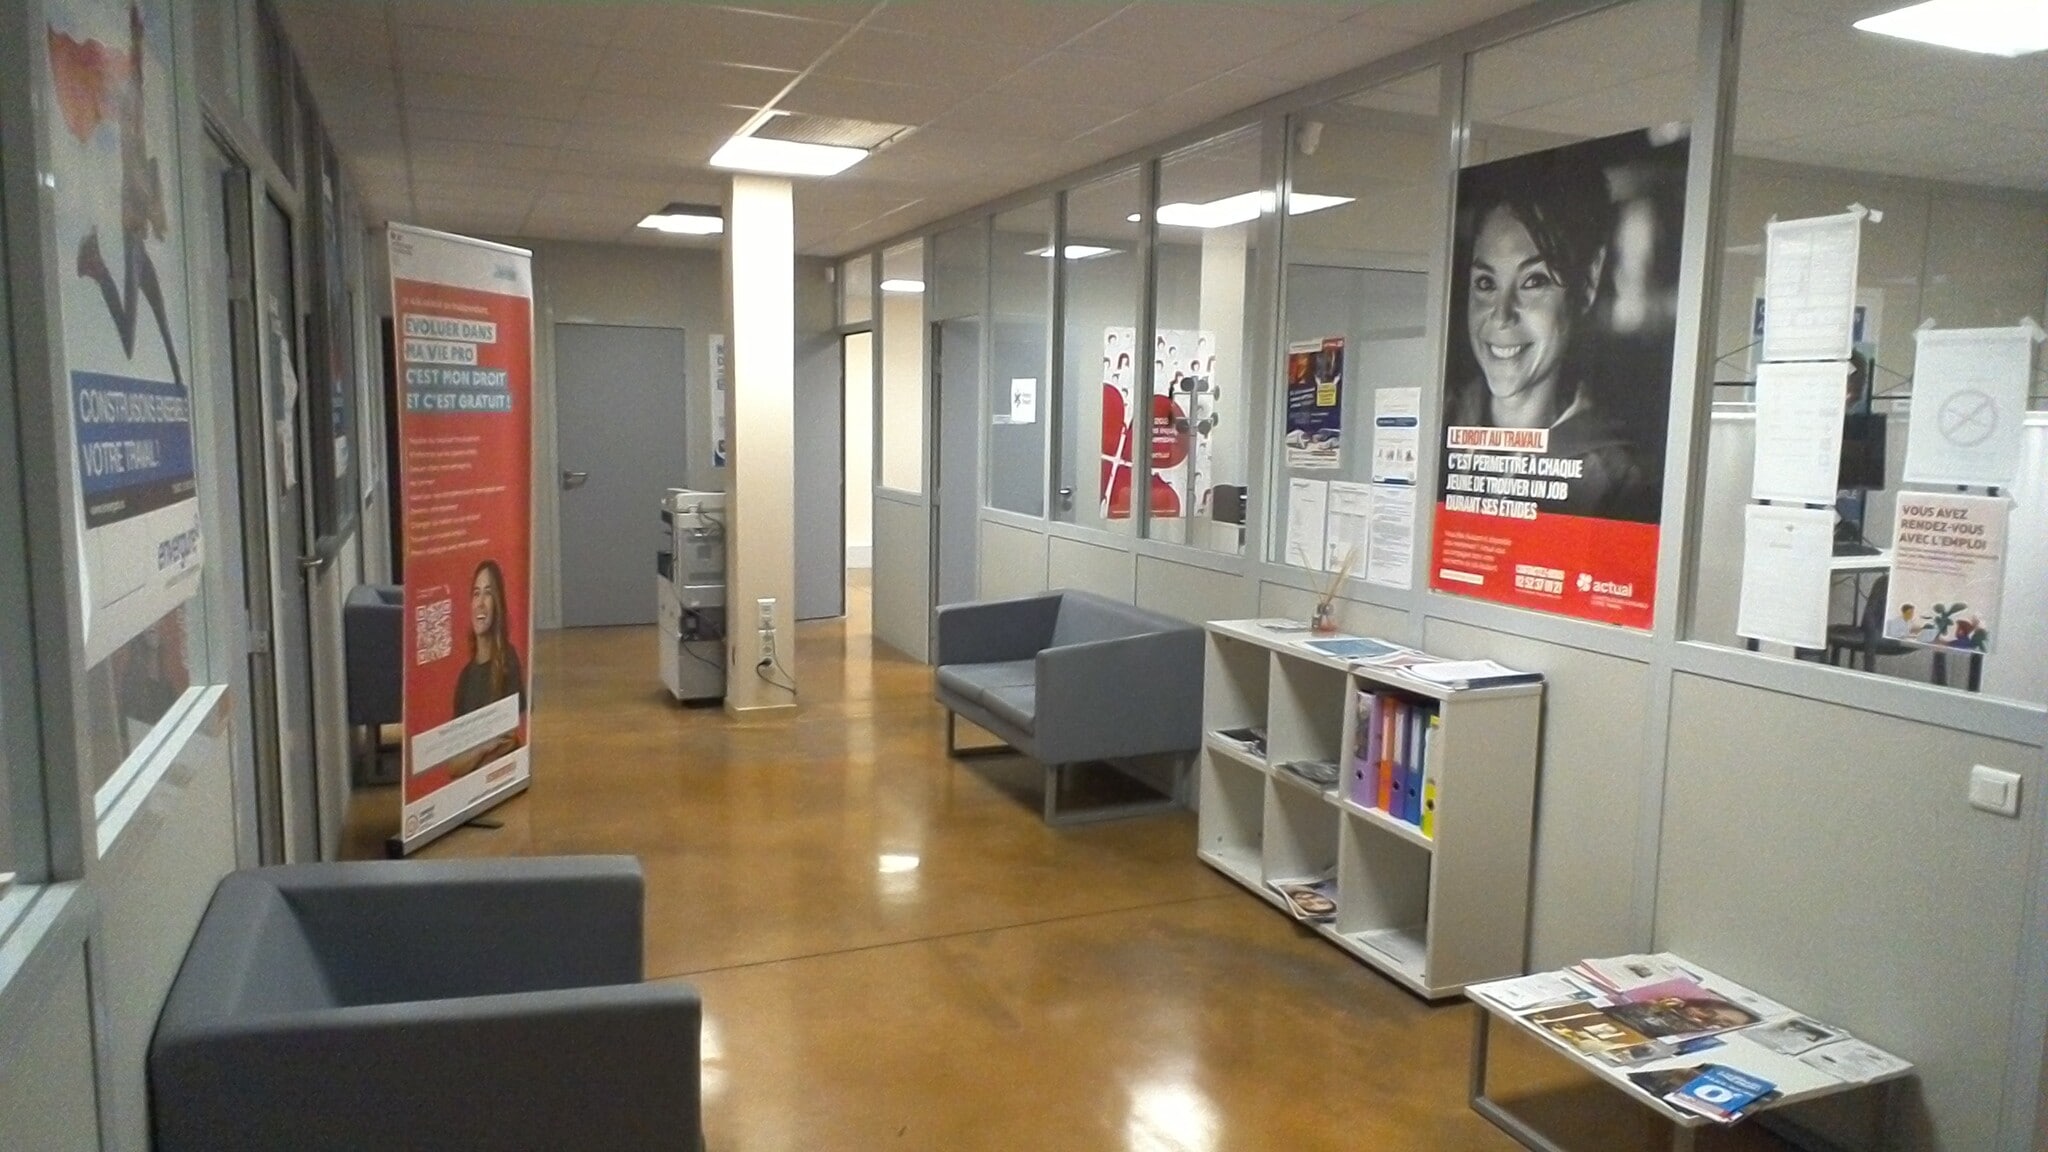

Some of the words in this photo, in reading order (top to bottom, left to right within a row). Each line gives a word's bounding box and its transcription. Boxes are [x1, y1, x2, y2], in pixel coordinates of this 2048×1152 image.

[462, 324, 493, 341] DANS
[427, 345, 448, 362] VIE
[451, 347, 474, 362] PRO
[406, 369, 440, 384] C'EST
[442, 370, 470, 385] MON
[472, 371, 506, 387] DROIT
[406, 394, 420, 409] ET
[422, 394, 457, 409] C'EST
[1450, 429, 1462, 445] LE
[1462, 430, 1488, 446] DROIT
[1488, 431, 1502, 447] AU
[1503, 431, 1544, 449] TRAVAIL
[82, 440, 125, 476] VOTRE
[1448, 453, 1472, 471] C'EST
[1472, 454, 1530, 475] PERMETTRE
[1538, 458, 1584, 479] CHAQUE
[1446, 474, 1473, 492] JEUNE
[1473, 476, 1486, 492] DE
[1486, 477, 1530, 498] TROUVER
[1530, 480, 1547, 499] UN
[1546, 481, 1568, 500] JOB
[1446, 494, 1480, 514] DURANT
[1480, 498, 1499, 516] SES
[1499, 496, 1538, 520] ÉTUDES
[1902, 504, 1934, 516] VOUS
[1936, 508, 1968, 520] AVEZ
[1901, 519, 1984, 536] RENDEZ-VOUS
[1900, 532, 1930, 545] AVEC
[1932, 536, 1987, 550] L'EMPLOI
[1592, 580, 1633, 598] actual
